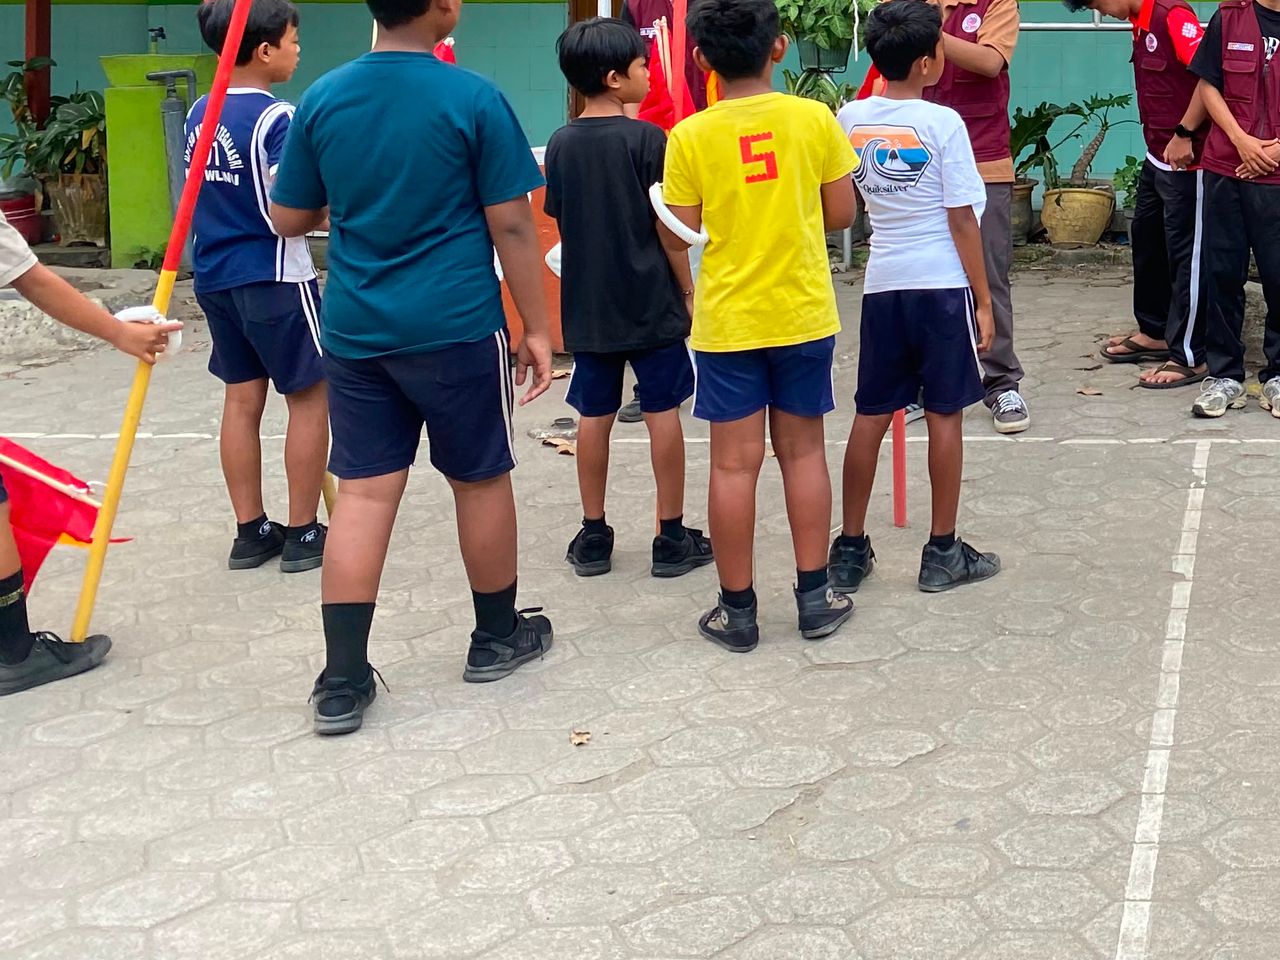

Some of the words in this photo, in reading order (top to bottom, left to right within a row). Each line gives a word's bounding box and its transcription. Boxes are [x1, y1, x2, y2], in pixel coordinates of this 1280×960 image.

[216, 125, 245, 170] TEGALASRI
[738, 131, 779, 184] 5
[863, 184, 909, 195] Quiksilver
